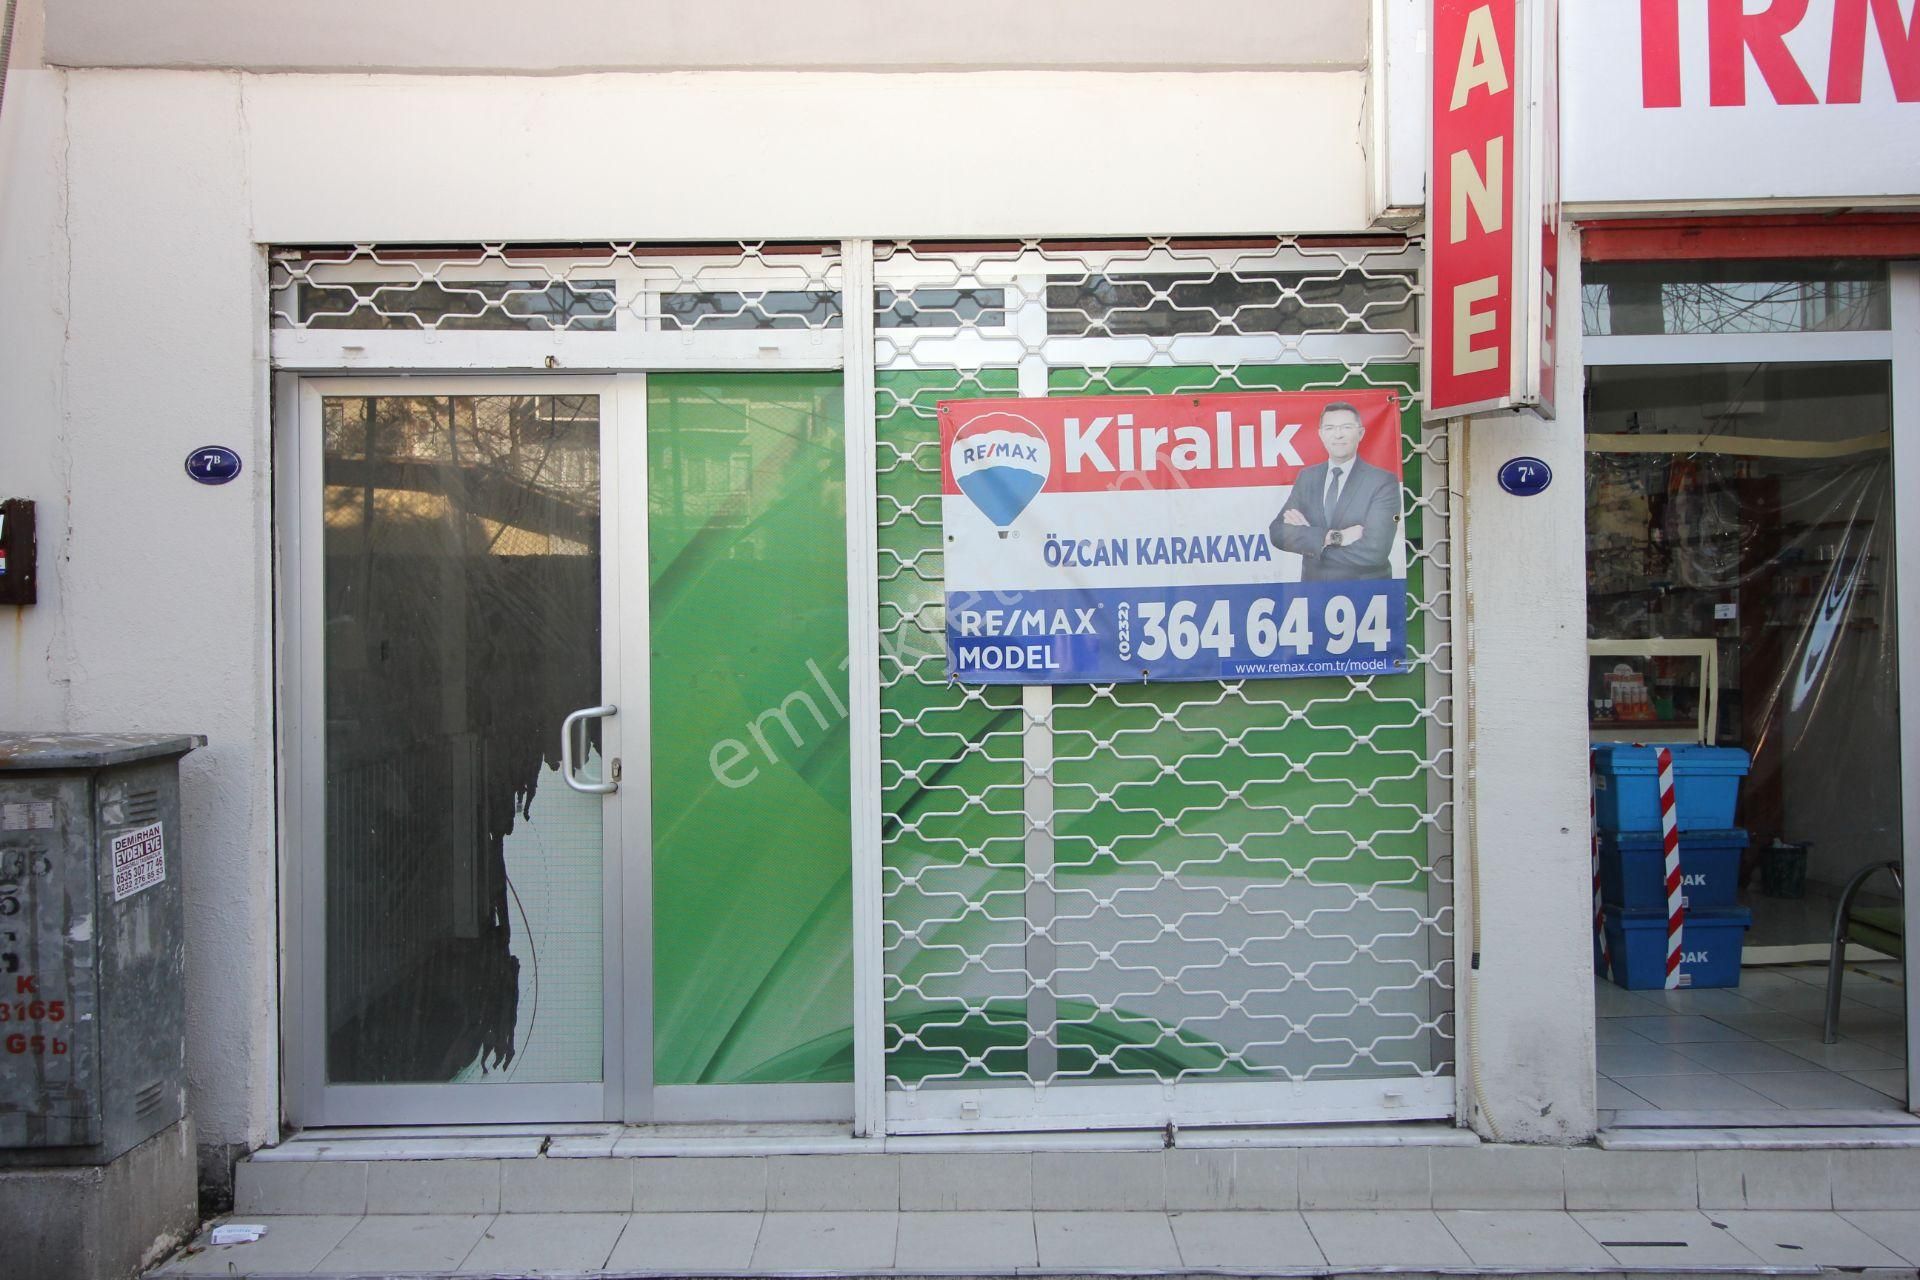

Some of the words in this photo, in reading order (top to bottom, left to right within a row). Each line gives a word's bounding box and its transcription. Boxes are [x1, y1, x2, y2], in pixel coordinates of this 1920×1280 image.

[963, 442, 1038, 465] RE/MAX
[1063, 410, 1305, 474] Kiralık
[1043, 533, 1129, 568] ÖZCAN
[1136, 534, 1272, 566] KARAKAYA
[961, 607, 1098, 637] RE/MAX
[1137, 599, 1235, 662] 364
[1246, 597, 1313, 658] 64
[1324, 594, 1392, 656] 94
[959, 645, 1060, 670] MODEL
[1235, 658, 1388, 674] www.remax.com.tr/model
